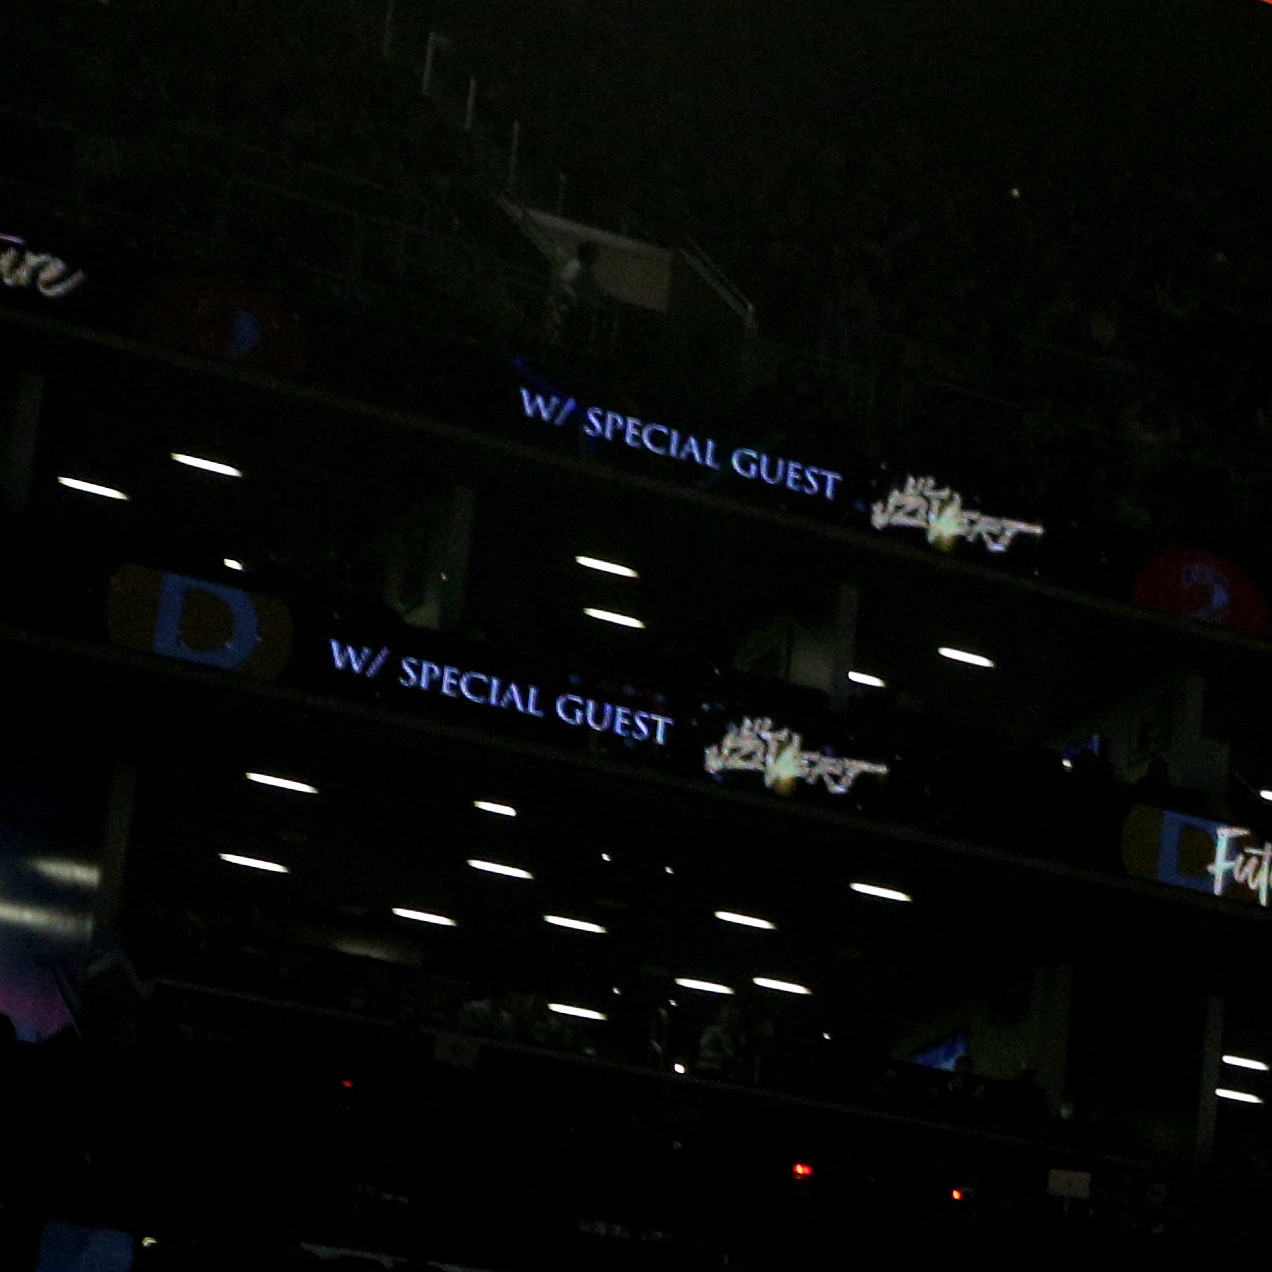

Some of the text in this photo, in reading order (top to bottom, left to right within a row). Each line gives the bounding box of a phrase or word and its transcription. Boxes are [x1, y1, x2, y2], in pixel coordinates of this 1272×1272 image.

[520, 387, 843, 499] W/ SPECIAL GUEST
[330, 639, 675, 747] W/ SPECIAL GUEST
